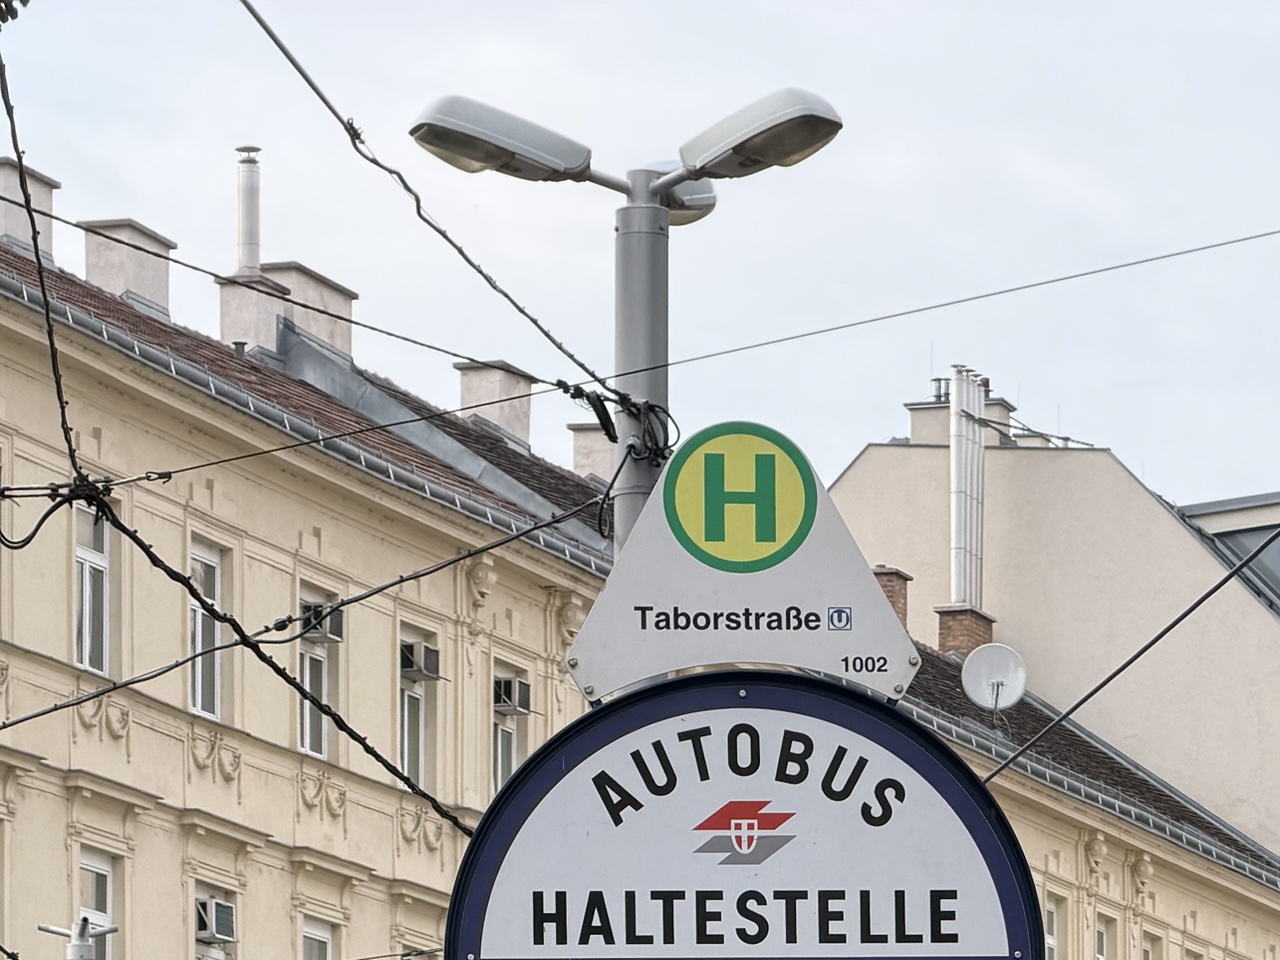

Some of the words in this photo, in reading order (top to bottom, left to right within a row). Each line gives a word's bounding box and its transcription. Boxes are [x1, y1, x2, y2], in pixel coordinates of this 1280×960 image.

[703, 453, 776, 542] H
[633, 606, 821, 630] Taborstraße
[841, 656, 888, 673] 1002
[591, 723, 906, 827] AUTOBUS
[532, 889, 959, 946] HALTESTELLE
